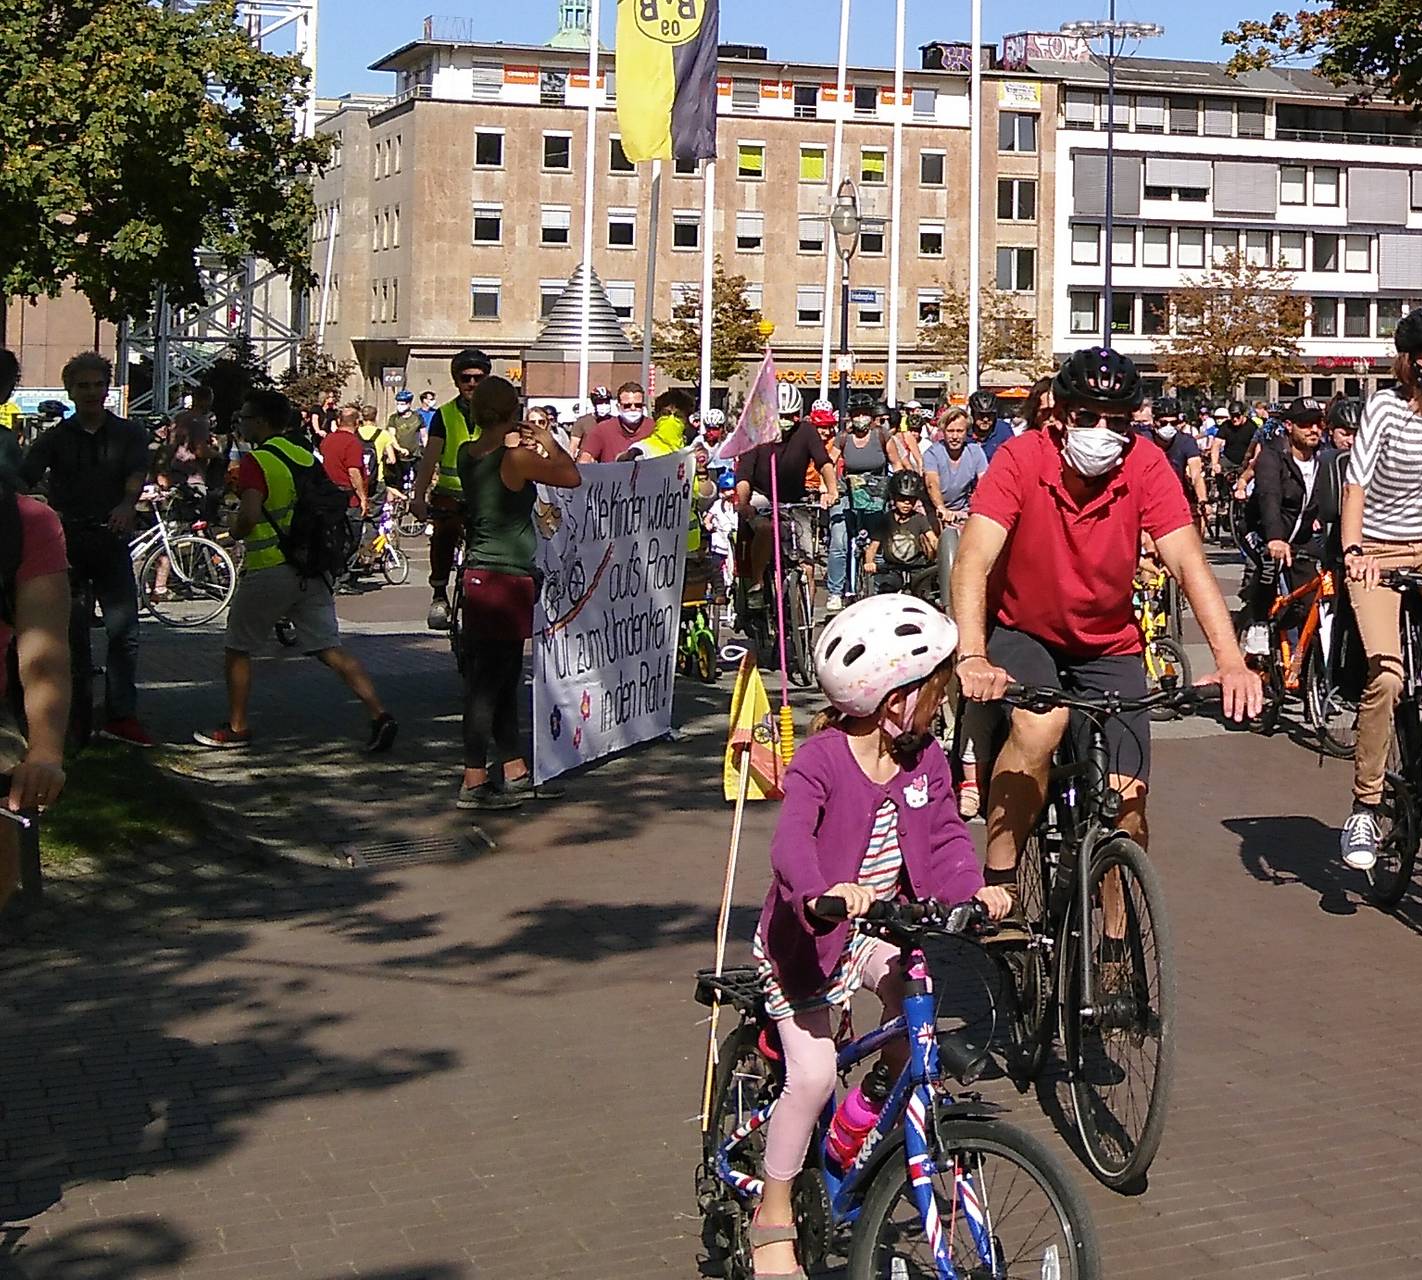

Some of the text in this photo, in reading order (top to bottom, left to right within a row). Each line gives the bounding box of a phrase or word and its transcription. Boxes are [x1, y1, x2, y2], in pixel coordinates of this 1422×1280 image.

[580, 481, 609, 543] Alle
[609, 481, 646, 540] Kinder
[609, 534, 678, 602] aufs Rad
[535, 597, 673, 683] Mut zum Umdenken
[614, 670, 636, 726] den
[639, 654, 671, 716] Rat!
